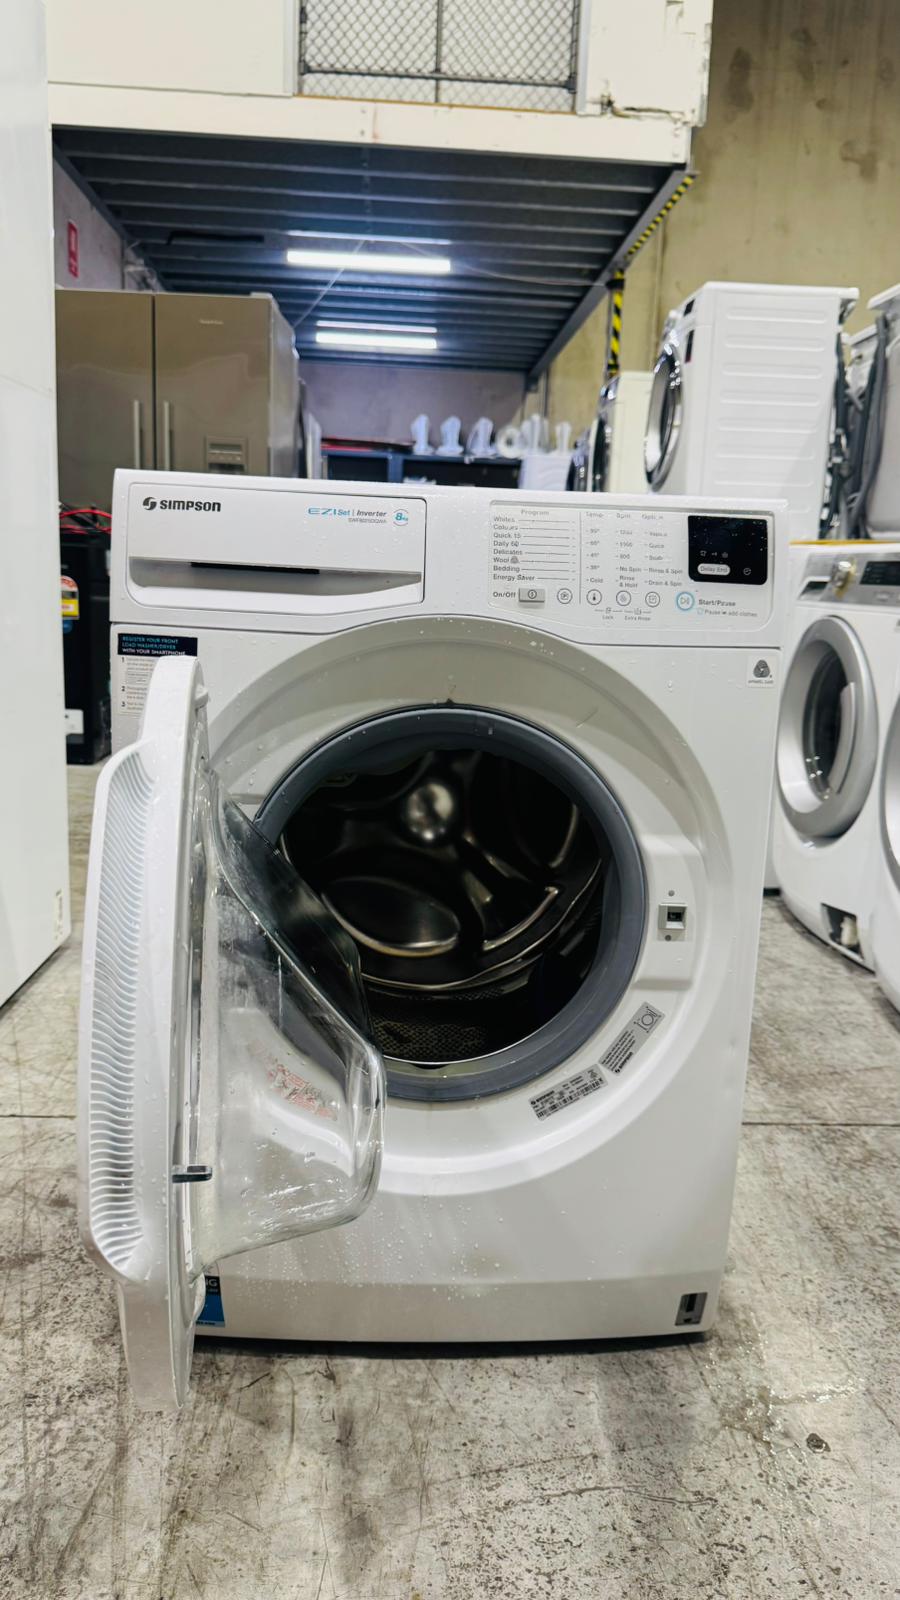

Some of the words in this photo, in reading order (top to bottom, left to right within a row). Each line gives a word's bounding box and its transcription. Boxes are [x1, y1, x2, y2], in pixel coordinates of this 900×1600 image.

[160, 499, 221, 512] SIMPSON
[356, 509, 387, 517] Inverter
[520, 509, 549, 517] Program
[493, 540, 509, 548] Daily
[493, 565, 520, 573] Bedding
[493, 573, 515, 582] Energy
[492, 591, 516, 599] On/Off
